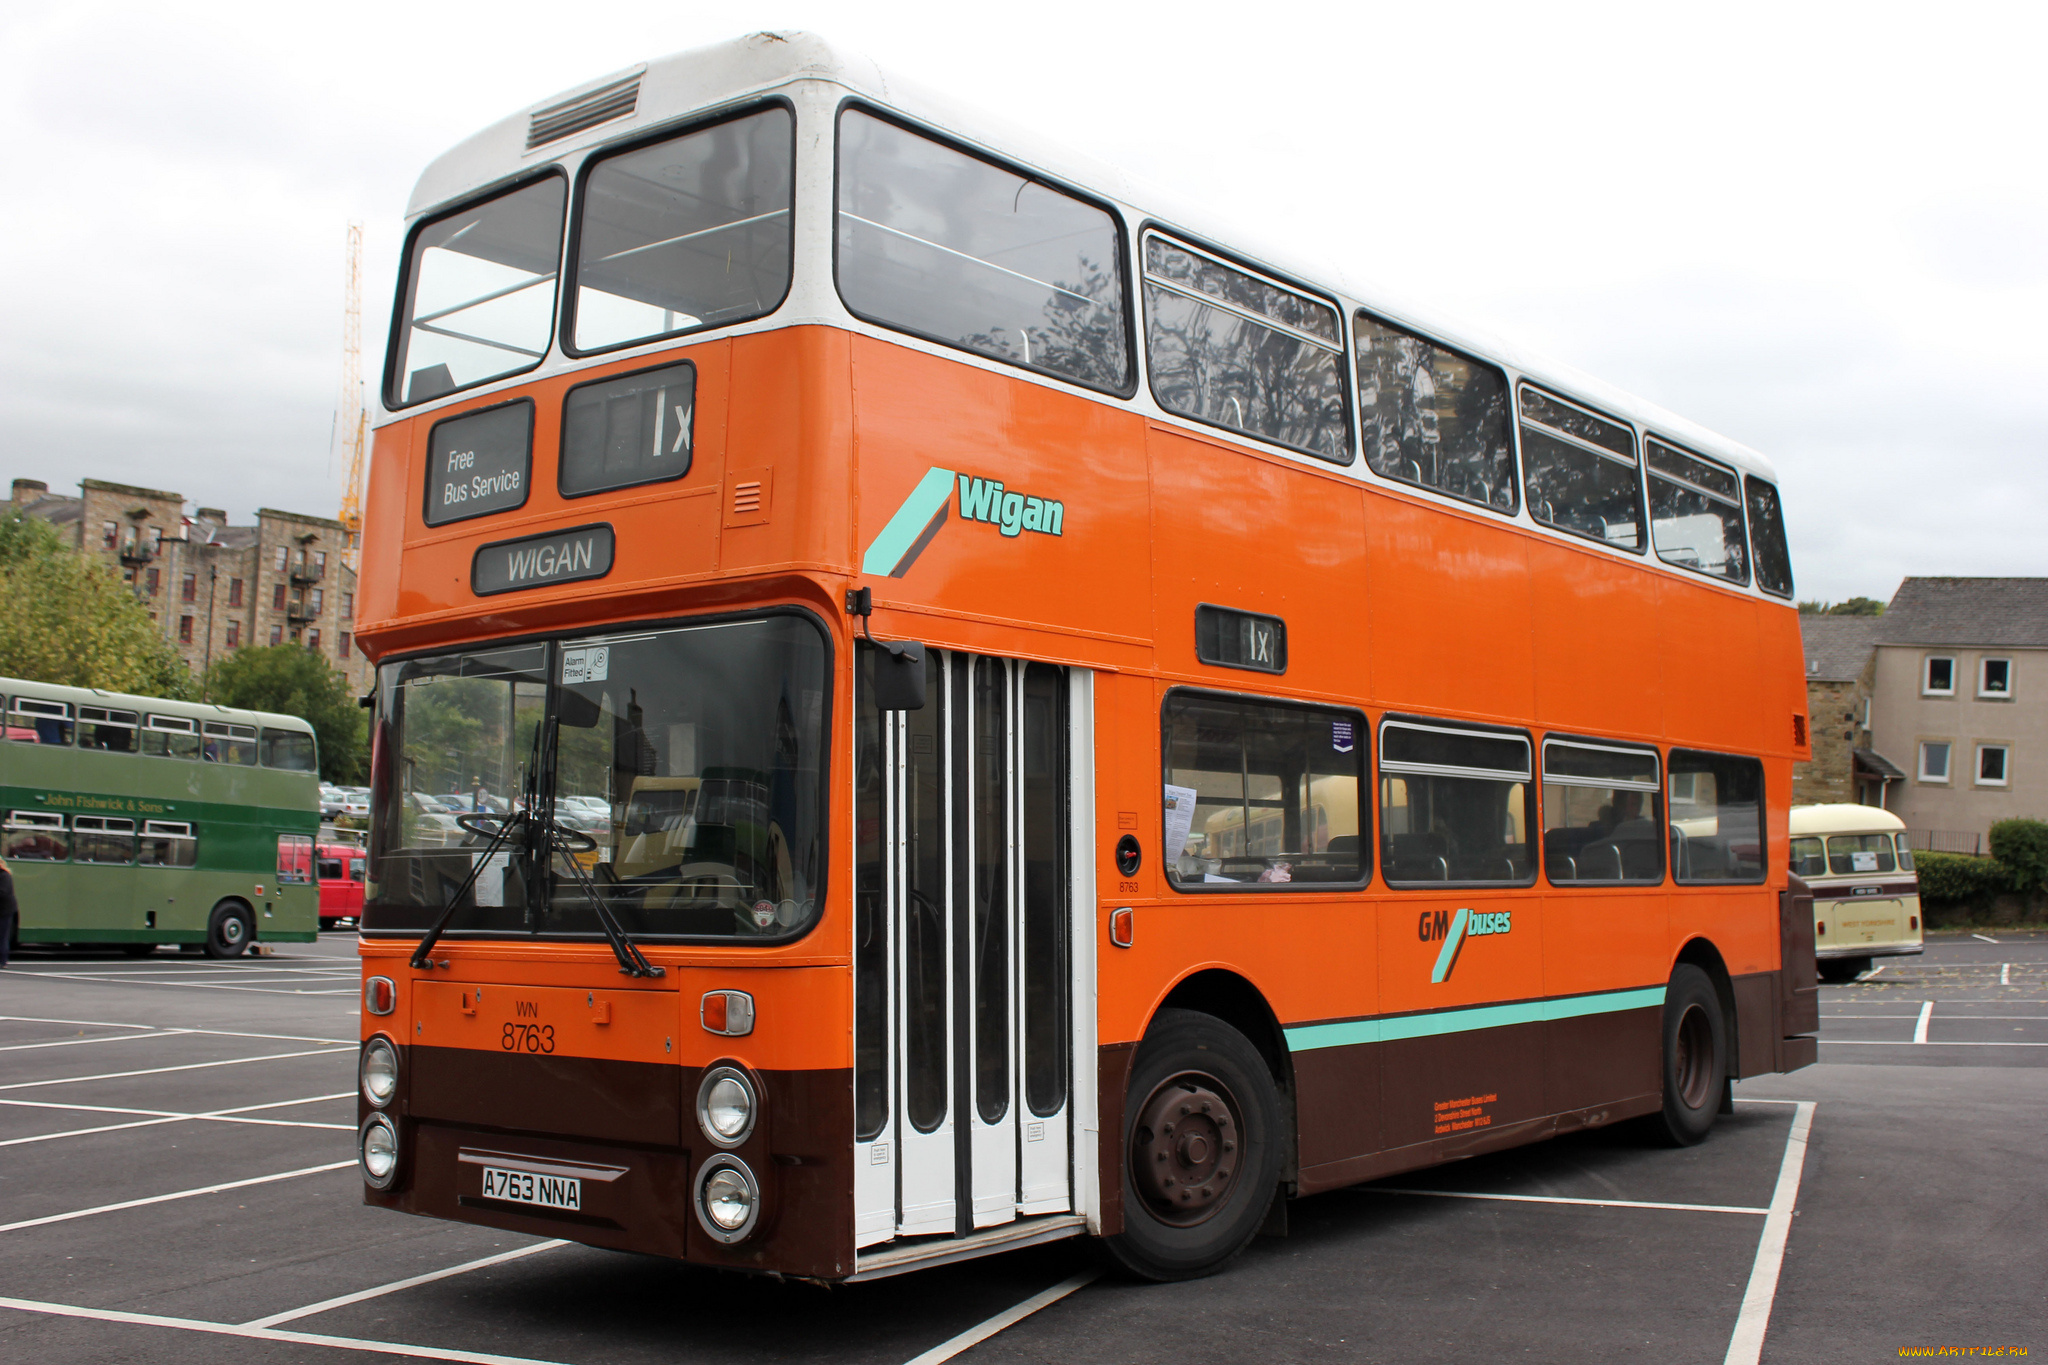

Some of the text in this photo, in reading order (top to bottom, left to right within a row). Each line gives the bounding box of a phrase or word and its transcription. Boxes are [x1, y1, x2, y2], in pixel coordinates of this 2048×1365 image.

[447, 449, 475, 472] Free
[444, 469, 520, 505] Bus Service
[957, 472, 1065, 538] Wigan
[508, 538, 593, 582] WIGAN
[564, 668, 583, 678] Fitted
[566, 658, 584, 667] Alarm
[43, 794, 163, 813] John Fishwick & Sons
[1119, 882, 1139, 893] 8763
[1419, 909, 1511, 942] GM buses
[516, 1001, 538, 1017] WN
[502, 1022, 555, 1053] 8763
[485, 1171, 579, 1209] A763 NNA
